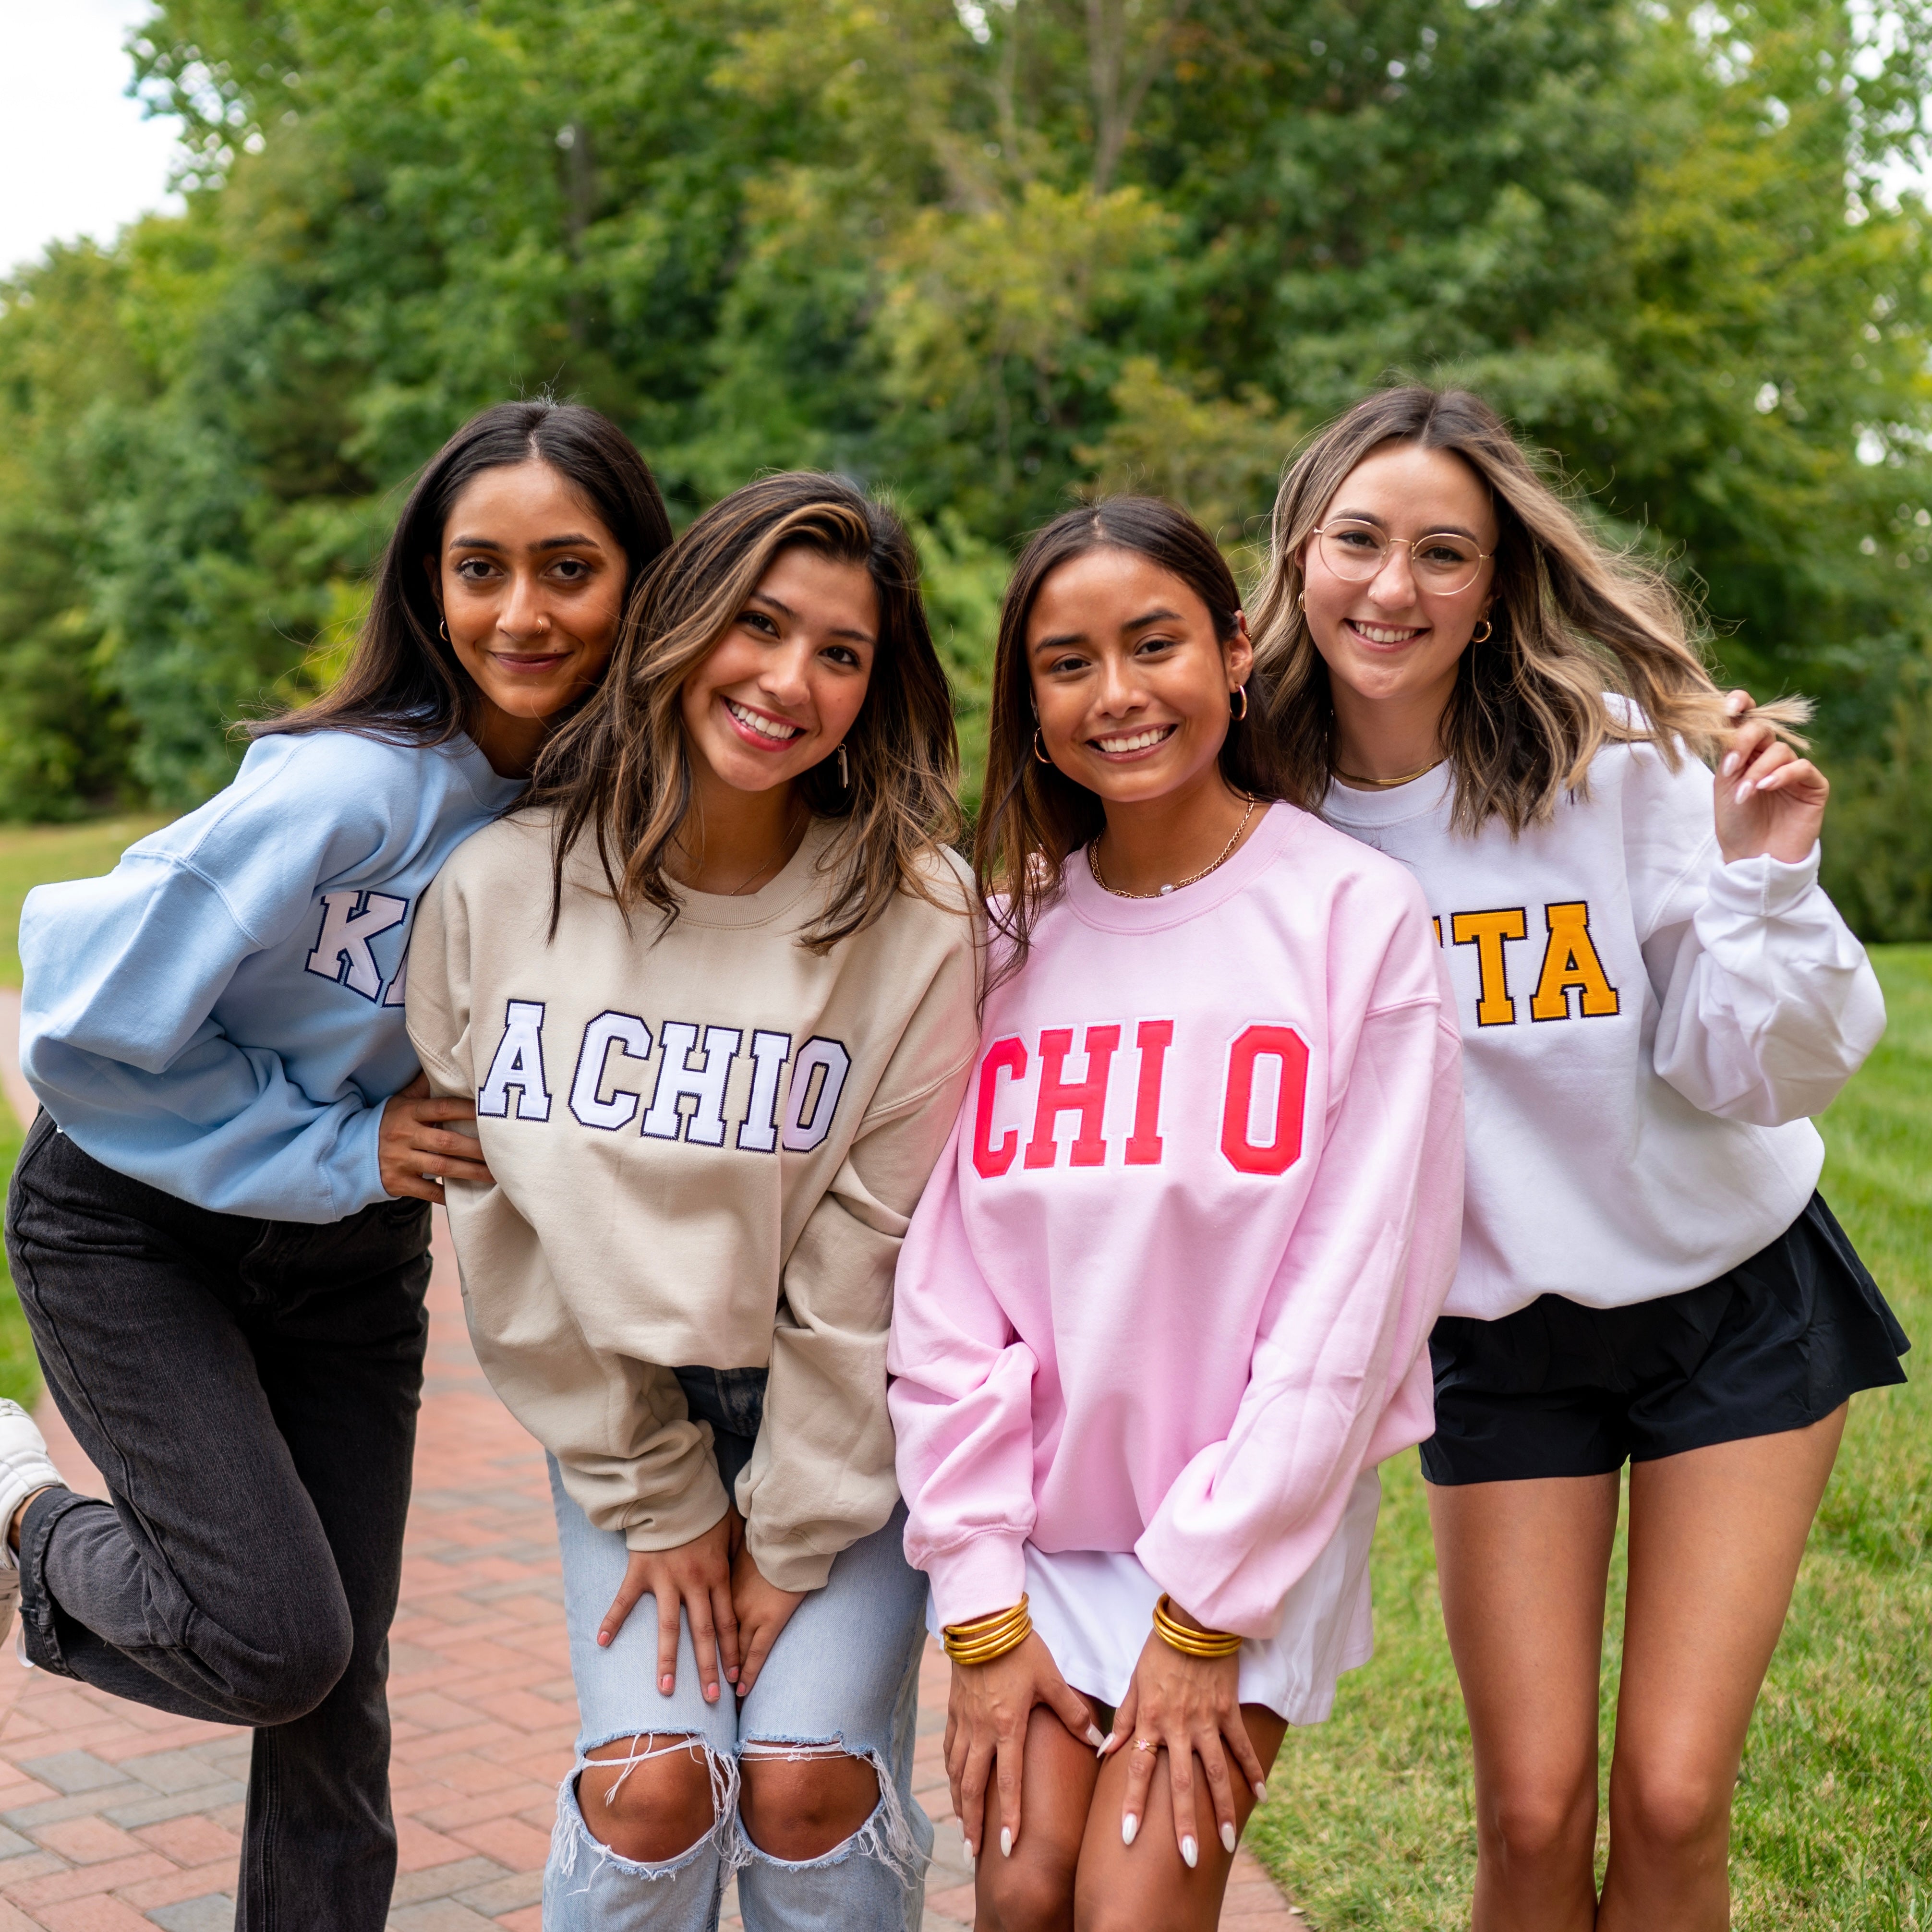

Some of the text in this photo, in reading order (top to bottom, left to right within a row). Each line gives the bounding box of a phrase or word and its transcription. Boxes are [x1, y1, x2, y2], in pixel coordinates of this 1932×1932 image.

[304, 890, 411, 1008] K
[1432, 901, 1621, 1028] TA
[971, 1014, 1315, 1182] CHI O
